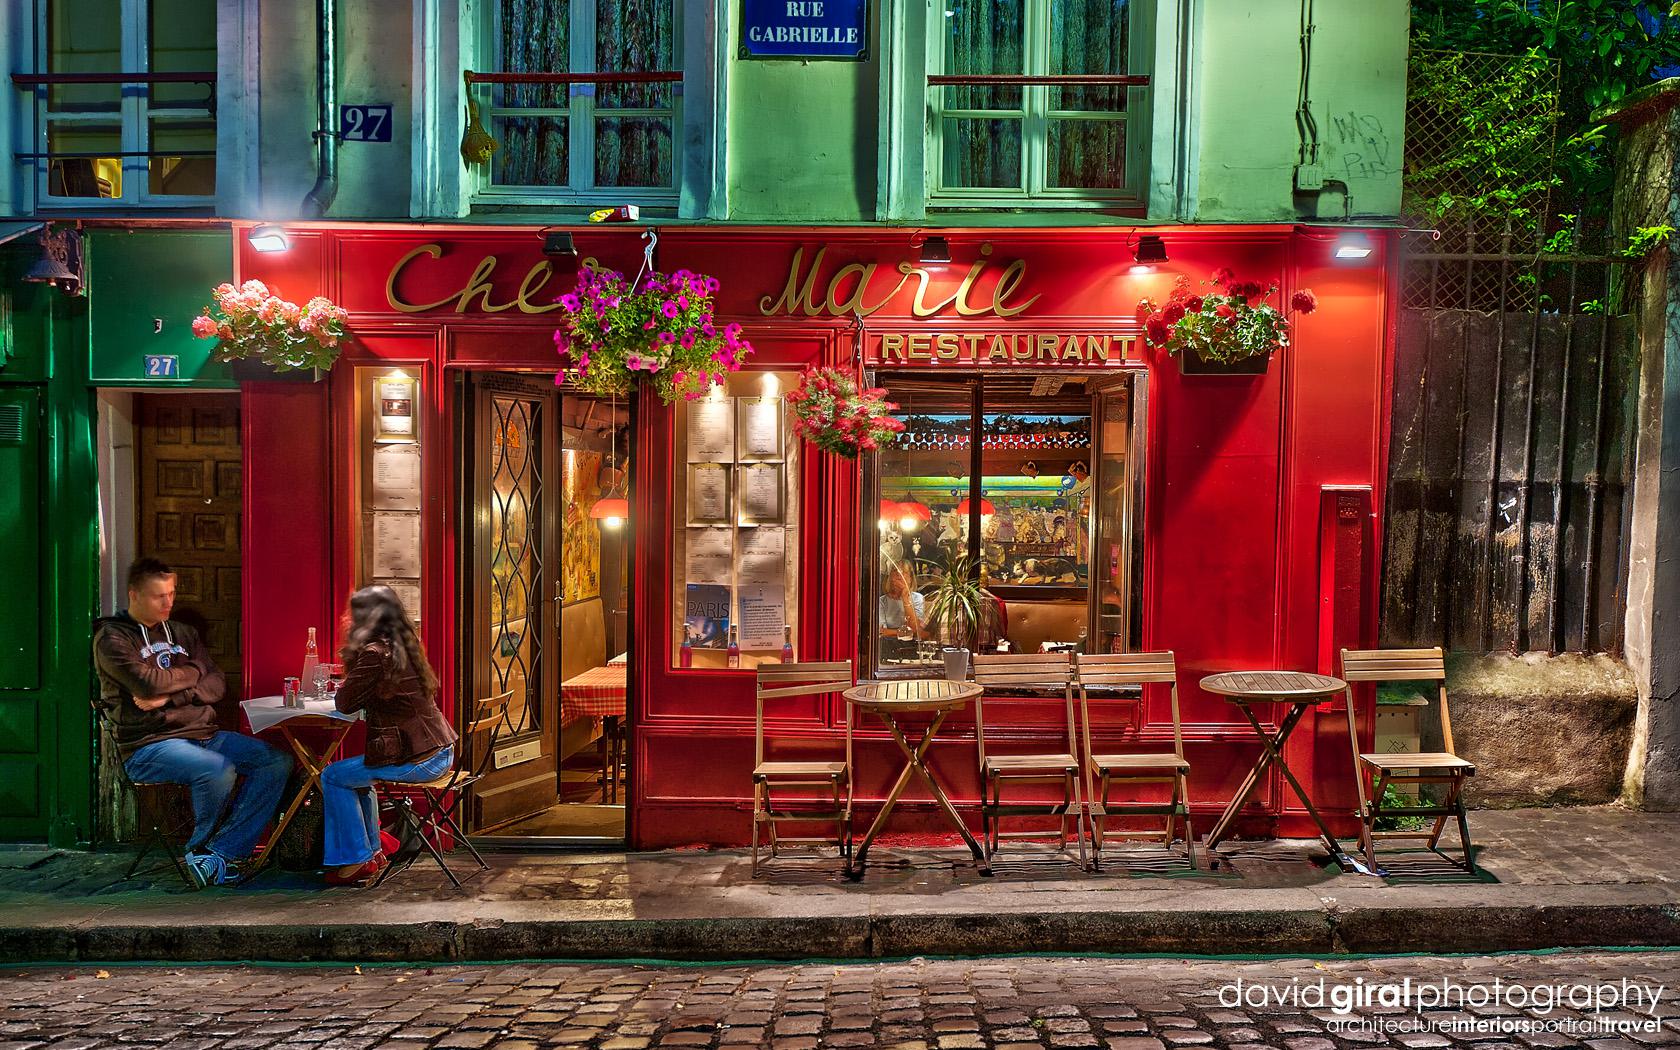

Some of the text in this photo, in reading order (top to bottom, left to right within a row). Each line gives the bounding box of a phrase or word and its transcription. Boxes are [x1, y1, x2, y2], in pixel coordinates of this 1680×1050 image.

[786, 1, 824, 17] RUE
[749, 26, 858, 43] GABRIELLE
[345, 107, 388, 141] 27
[759, 243, 1042, 317] Marie
[882, 333, 1137, 361] RESTAURANT
[150, 358, 172, 376] 27
[687, 601, 730, 618] PARIS
